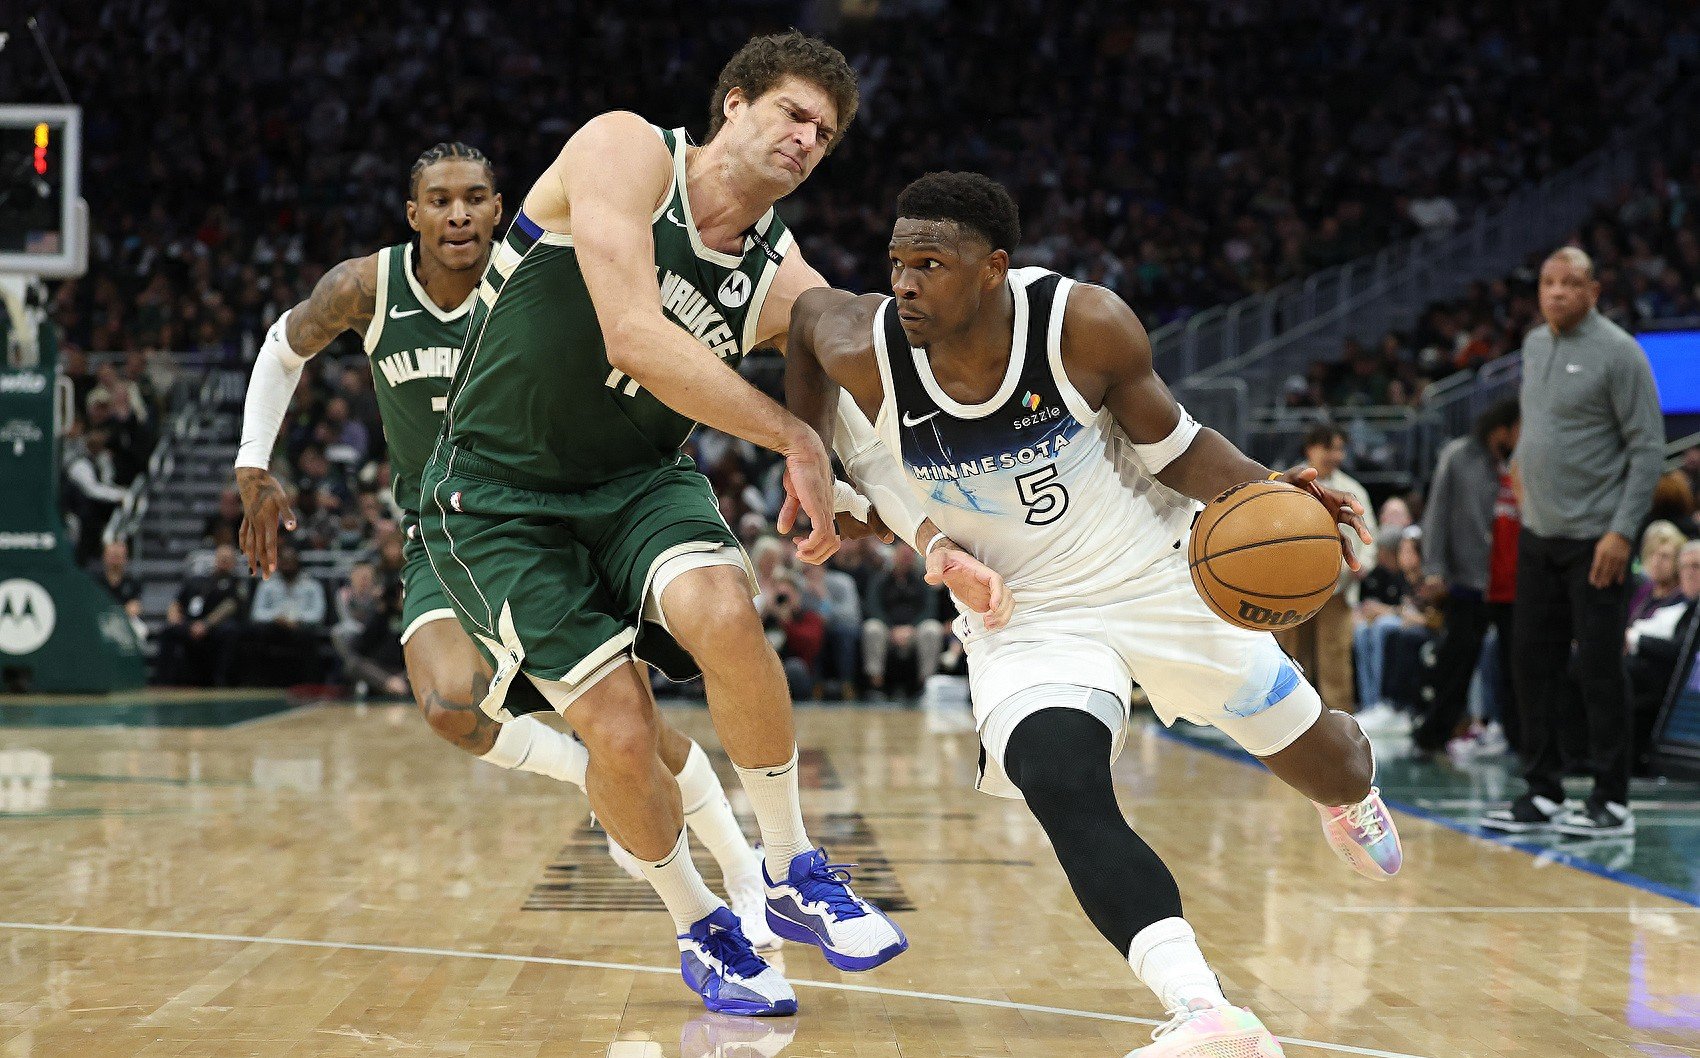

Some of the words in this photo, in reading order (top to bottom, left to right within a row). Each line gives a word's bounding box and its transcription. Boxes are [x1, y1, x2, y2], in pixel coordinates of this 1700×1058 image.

[655, 265, 739, 359] WAUKEE
[1013, 406, 1061, 430] sezzle
[912, 433, 1071, 481] MINNESOTA
[1014, 462, 1070, 526] 5
